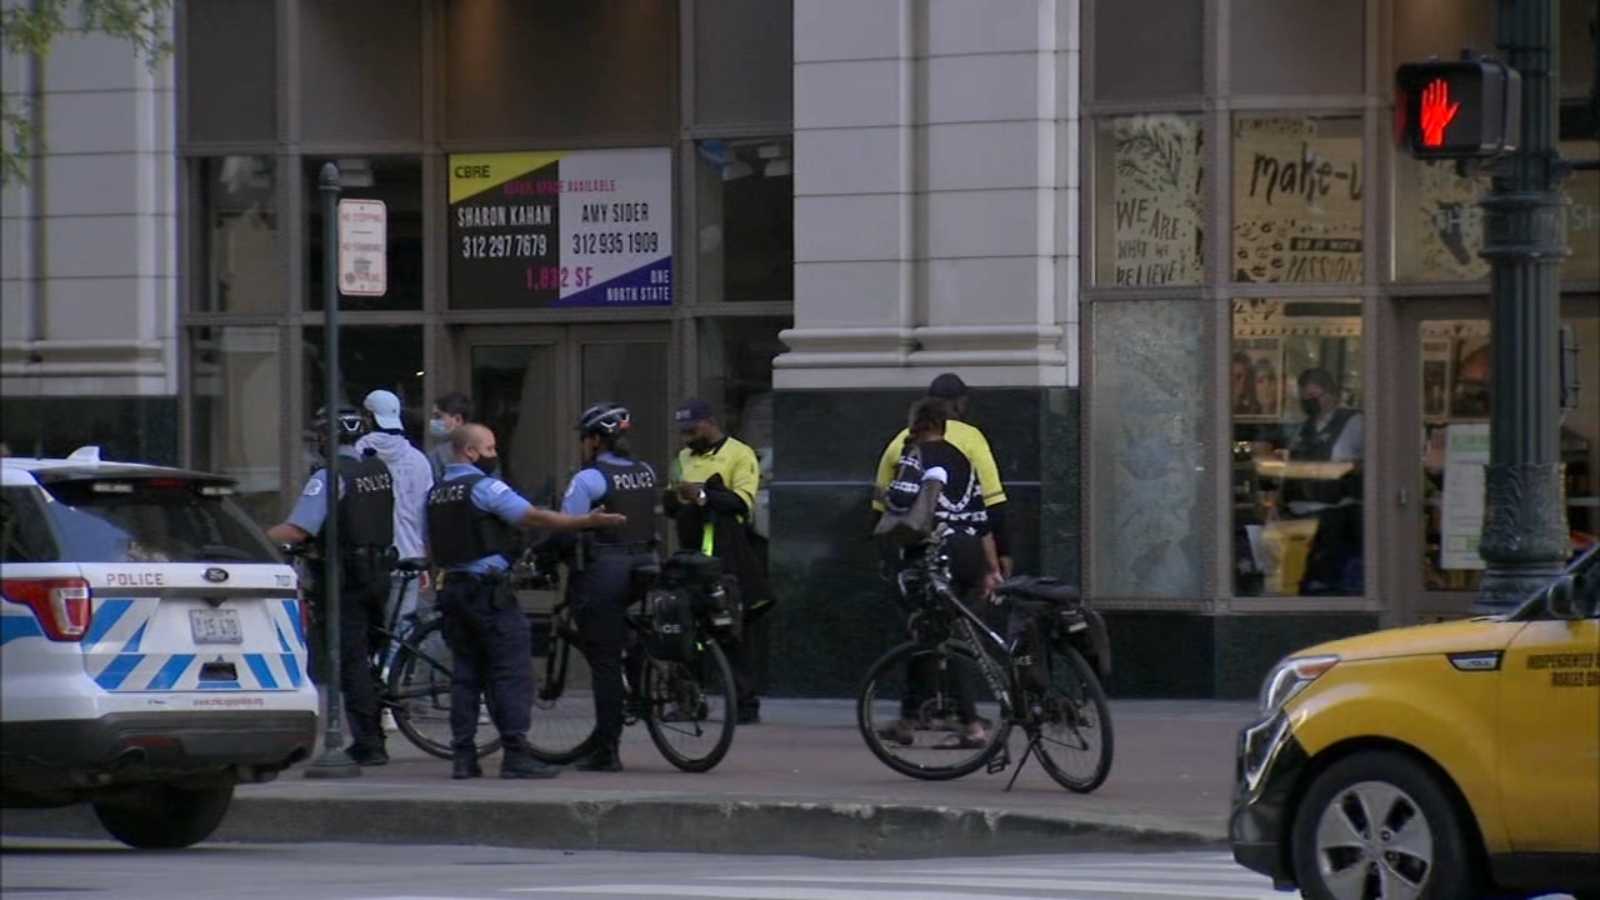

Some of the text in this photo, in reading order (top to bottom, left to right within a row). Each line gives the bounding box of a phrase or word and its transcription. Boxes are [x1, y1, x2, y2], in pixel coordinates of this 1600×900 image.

[454, 165, 491, 178] CBRE
[457, 205, 551, 227] SHARON KAHAN
[581, 203, 649, 222] AMY SIDER
[1116, 199, 1148, 230] WE
[462, 234, 547, 258] 312 297 7679
[573, 231, 658, 255] 312 935 1909
[575, 267, 594, 287] SF
[650, 270, 670, 284] ONE
[606, 287, 670, 301] NORTH STATE
[354, 473, 392, 494] POLICE
[613, 471, 654, 491] POLICE
[106, 573, 164, 586] POLICE
